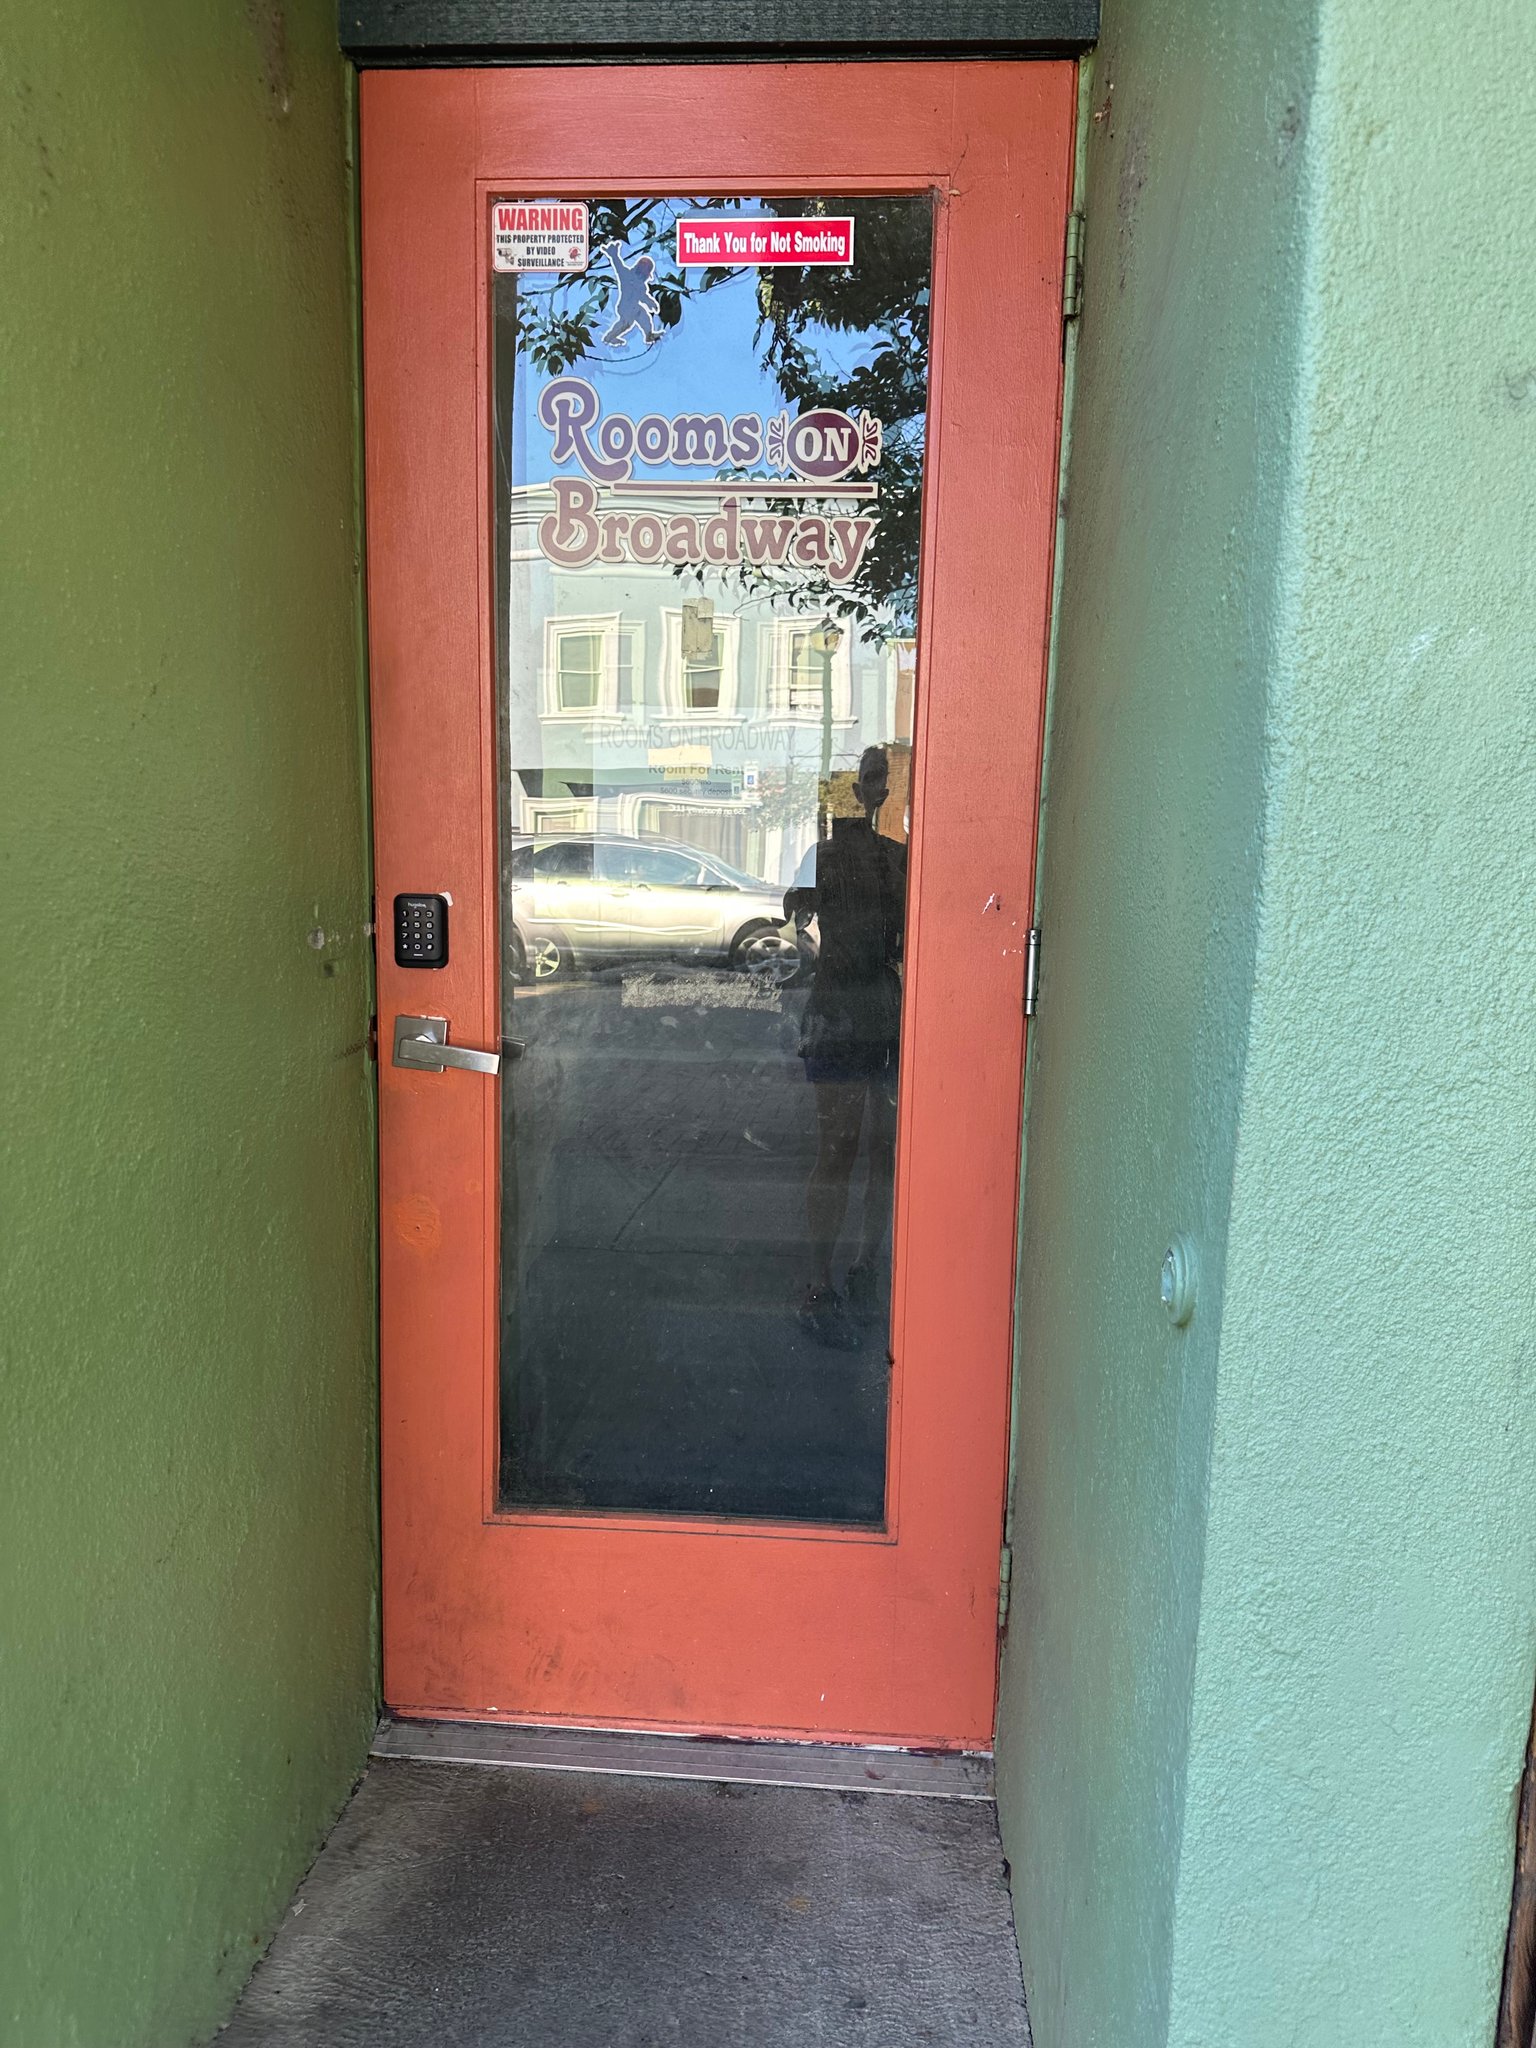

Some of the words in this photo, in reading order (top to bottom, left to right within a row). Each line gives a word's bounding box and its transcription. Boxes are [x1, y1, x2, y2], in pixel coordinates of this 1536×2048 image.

[498, 208, 583, 231] WARNING
[496, 234, 512, 244] THIS
[513, 234, 547, 244] PROPERTY
[547, 234, 584, 244] PROTECTED
[684, 232, 720, 254] Thank
[723, 232, 747, 253] You
[750, 231, 768, 253] for
[770, 231, 791, 253] Not
[794, 230, 846, 257] Smoking
[517, 258, 565, 267] SURVEILLANCE
[526, 246, 536, 255] BY
[536, 246, 556, 256] VIDEO
[539, 378, 763, 484] Rooms
[795, 427, 851, 462] ON
[539, 478, 875, 584] Broadway
[600, 725, 664, 749] ROOMS
[668, 726, 695, 748] ON
[699, 725, 797, 751] BROADWAY
[649, 764, 686, 774] Room
[690, 764, 710, 774] For
